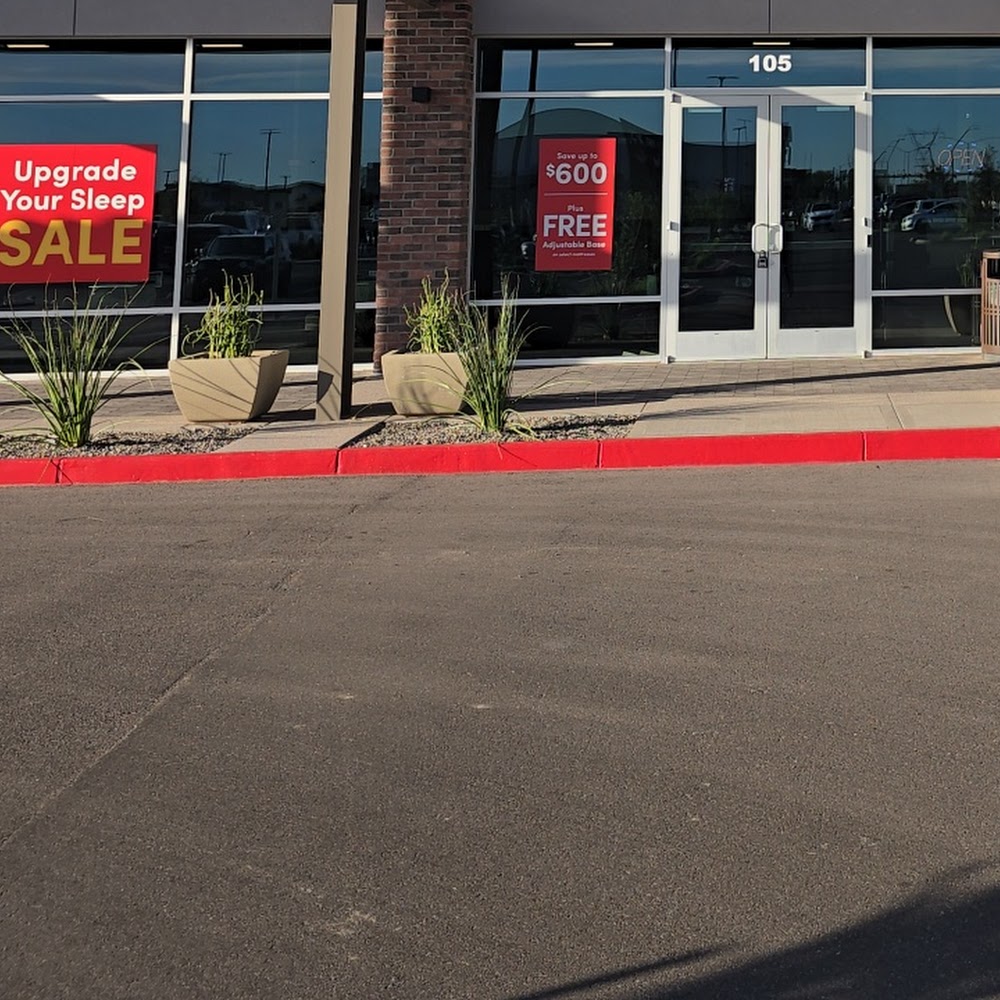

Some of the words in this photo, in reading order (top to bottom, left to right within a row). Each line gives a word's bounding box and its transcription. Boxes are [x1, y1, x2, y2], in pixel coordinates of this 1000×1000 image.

[748, 54, 792, 73] 105
[556, 152, 577, 160] Save
[577, 153, 589, 161] up
[589, 152, 599, 160] to
[937, 148, 986, 167] OPEN
[14, 158, 138, 188] Upgrade
[545, 162, 608, 185] $600
[0, 189, 63, 212] Your
[70, 187, 145, 216] Sleep
[566, 204, 584, 213] Plus
[543, 213, 608, 237] FREE
[0, 218, 144, 267] SALE
[542, 240, 585, 251] Adjustable
[586, 240, 607, 249] Base
